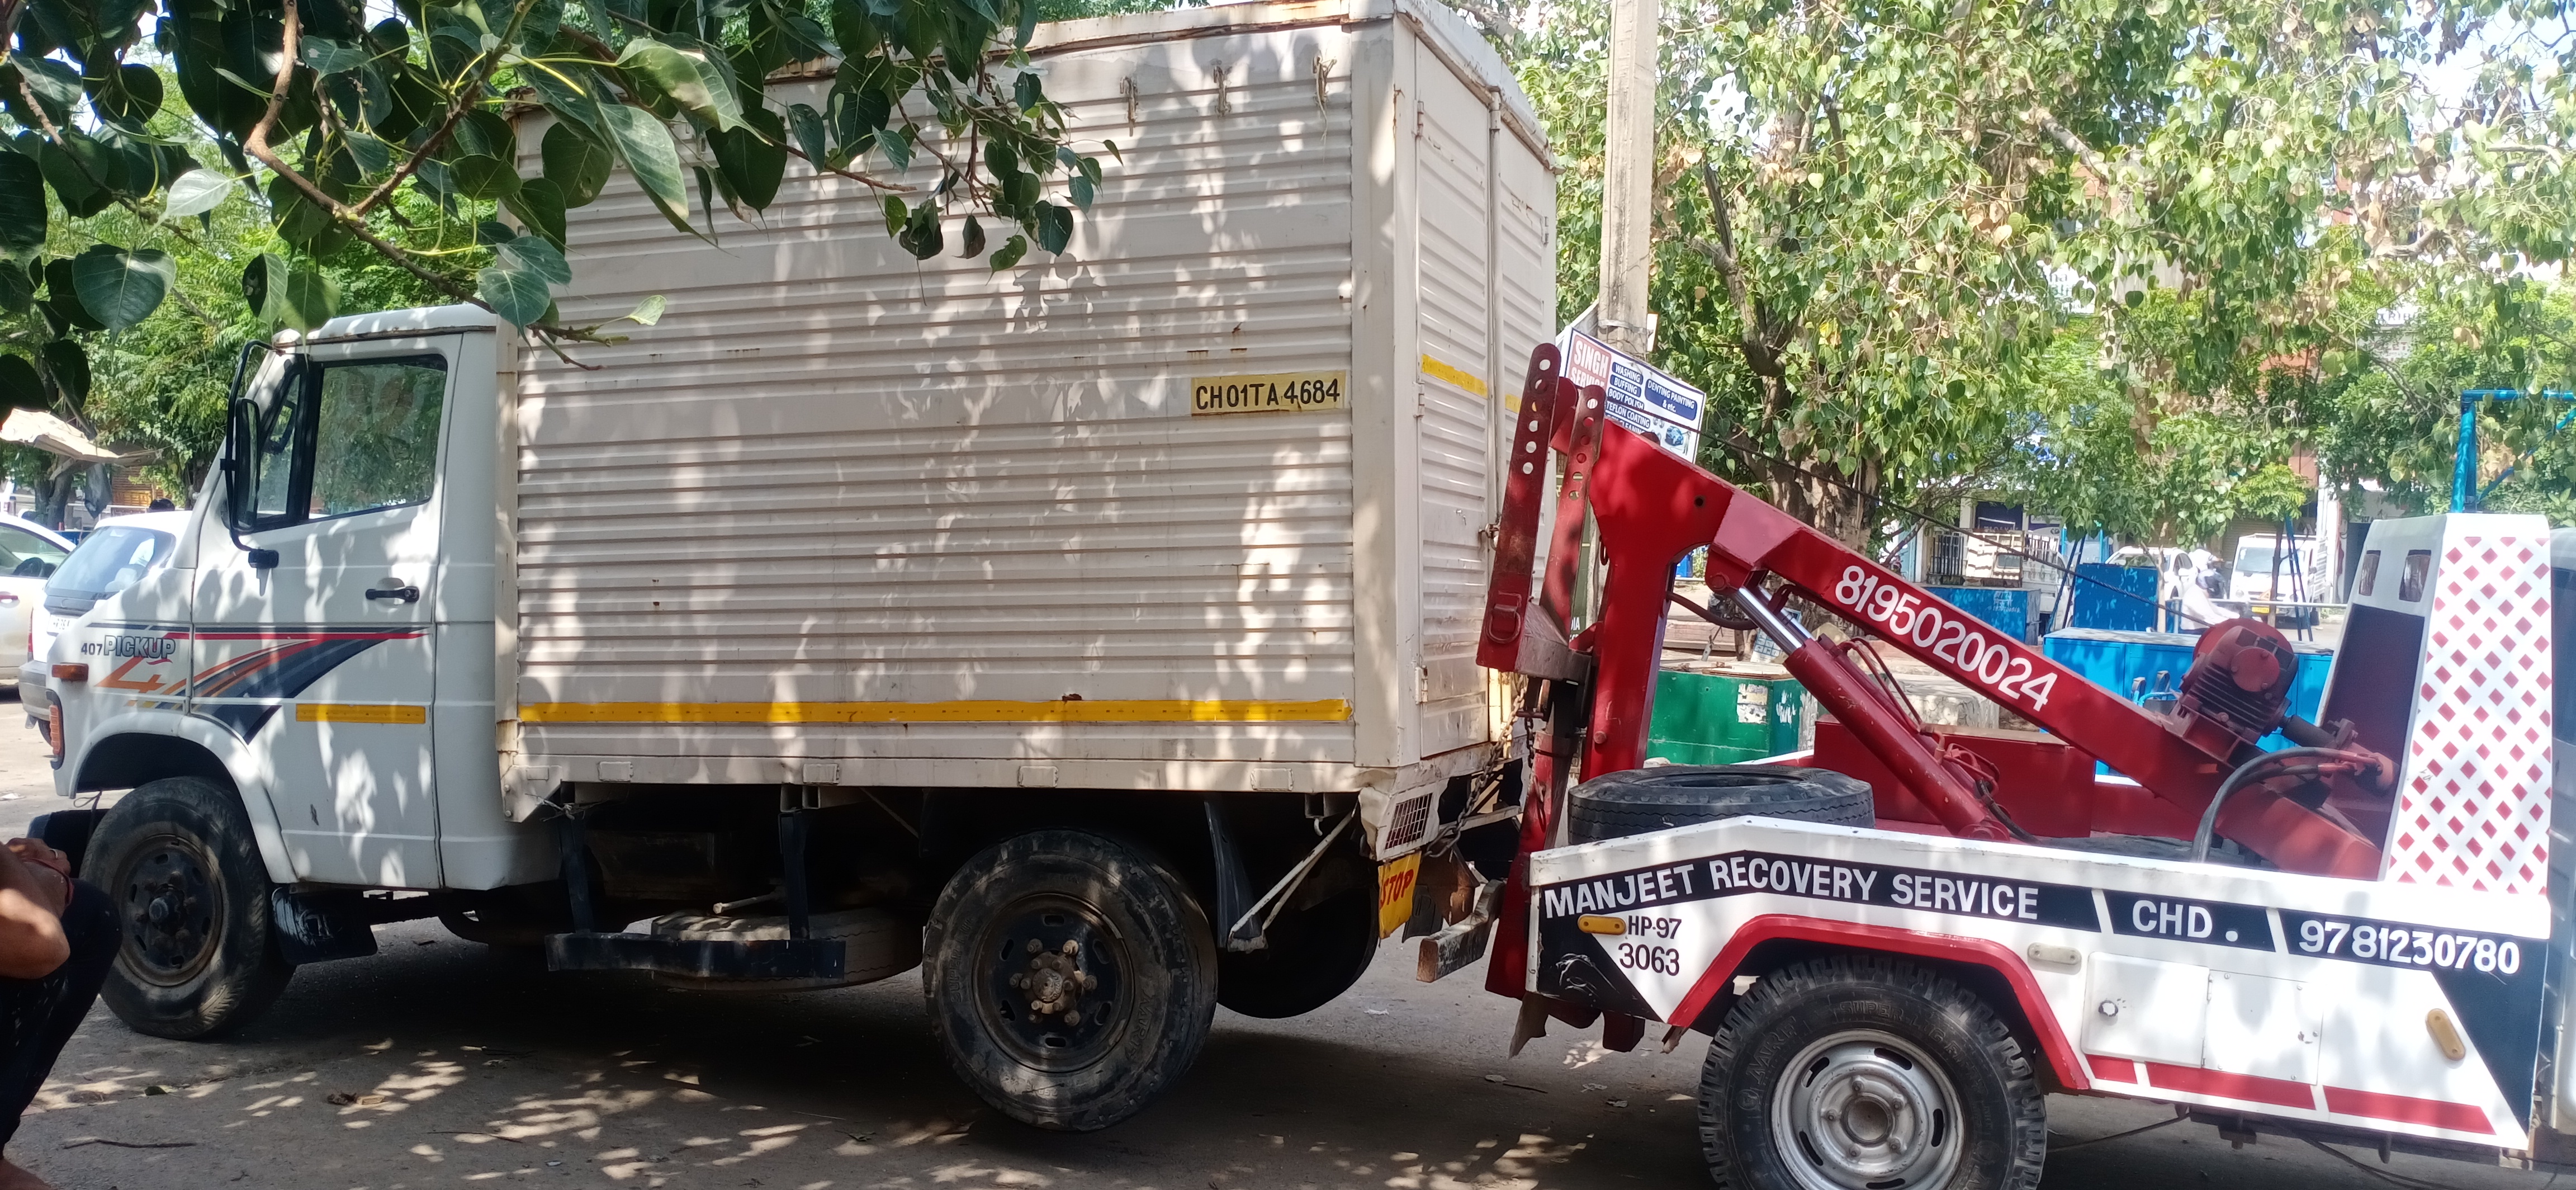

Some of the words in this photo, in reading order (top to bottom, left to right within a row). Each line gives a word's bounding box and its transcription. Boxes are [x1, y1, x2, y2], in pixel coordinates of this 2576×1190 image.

[1574, 340, 1609, 379] SINGH
[1615, 363, 1641, 383] WASHING
[1608, 388, 1625, 402] BODY
[1624, 396, 1644, 410] POLISH
[1614, 377, 1637, 395] BUFFING
[1647, 380, 1670, 399] DENTING
[1670, 392, 1695, 409] PAINTING
[1606, 400, 1627, 417] TEFLON
[1627, 410, 1650, 428] COATING
[80, 643, 103, 656] 407
[103, 635, 176, 659] PICKUP
[1835, 565, 2058, 712] 8195020024
[1379, 868, 1414, 910] STOP
[1544, 863, 1696, 919] MANJEET
[1711, 857, 1878, 902] RECOVERY
[1891, 874, 2039, 920] SERVICE
[2298, 920, 2520, 975] 9781230780
[1628, 915, 1683, 941] HP-97
[1618, 942, 1680, 977] 3063
